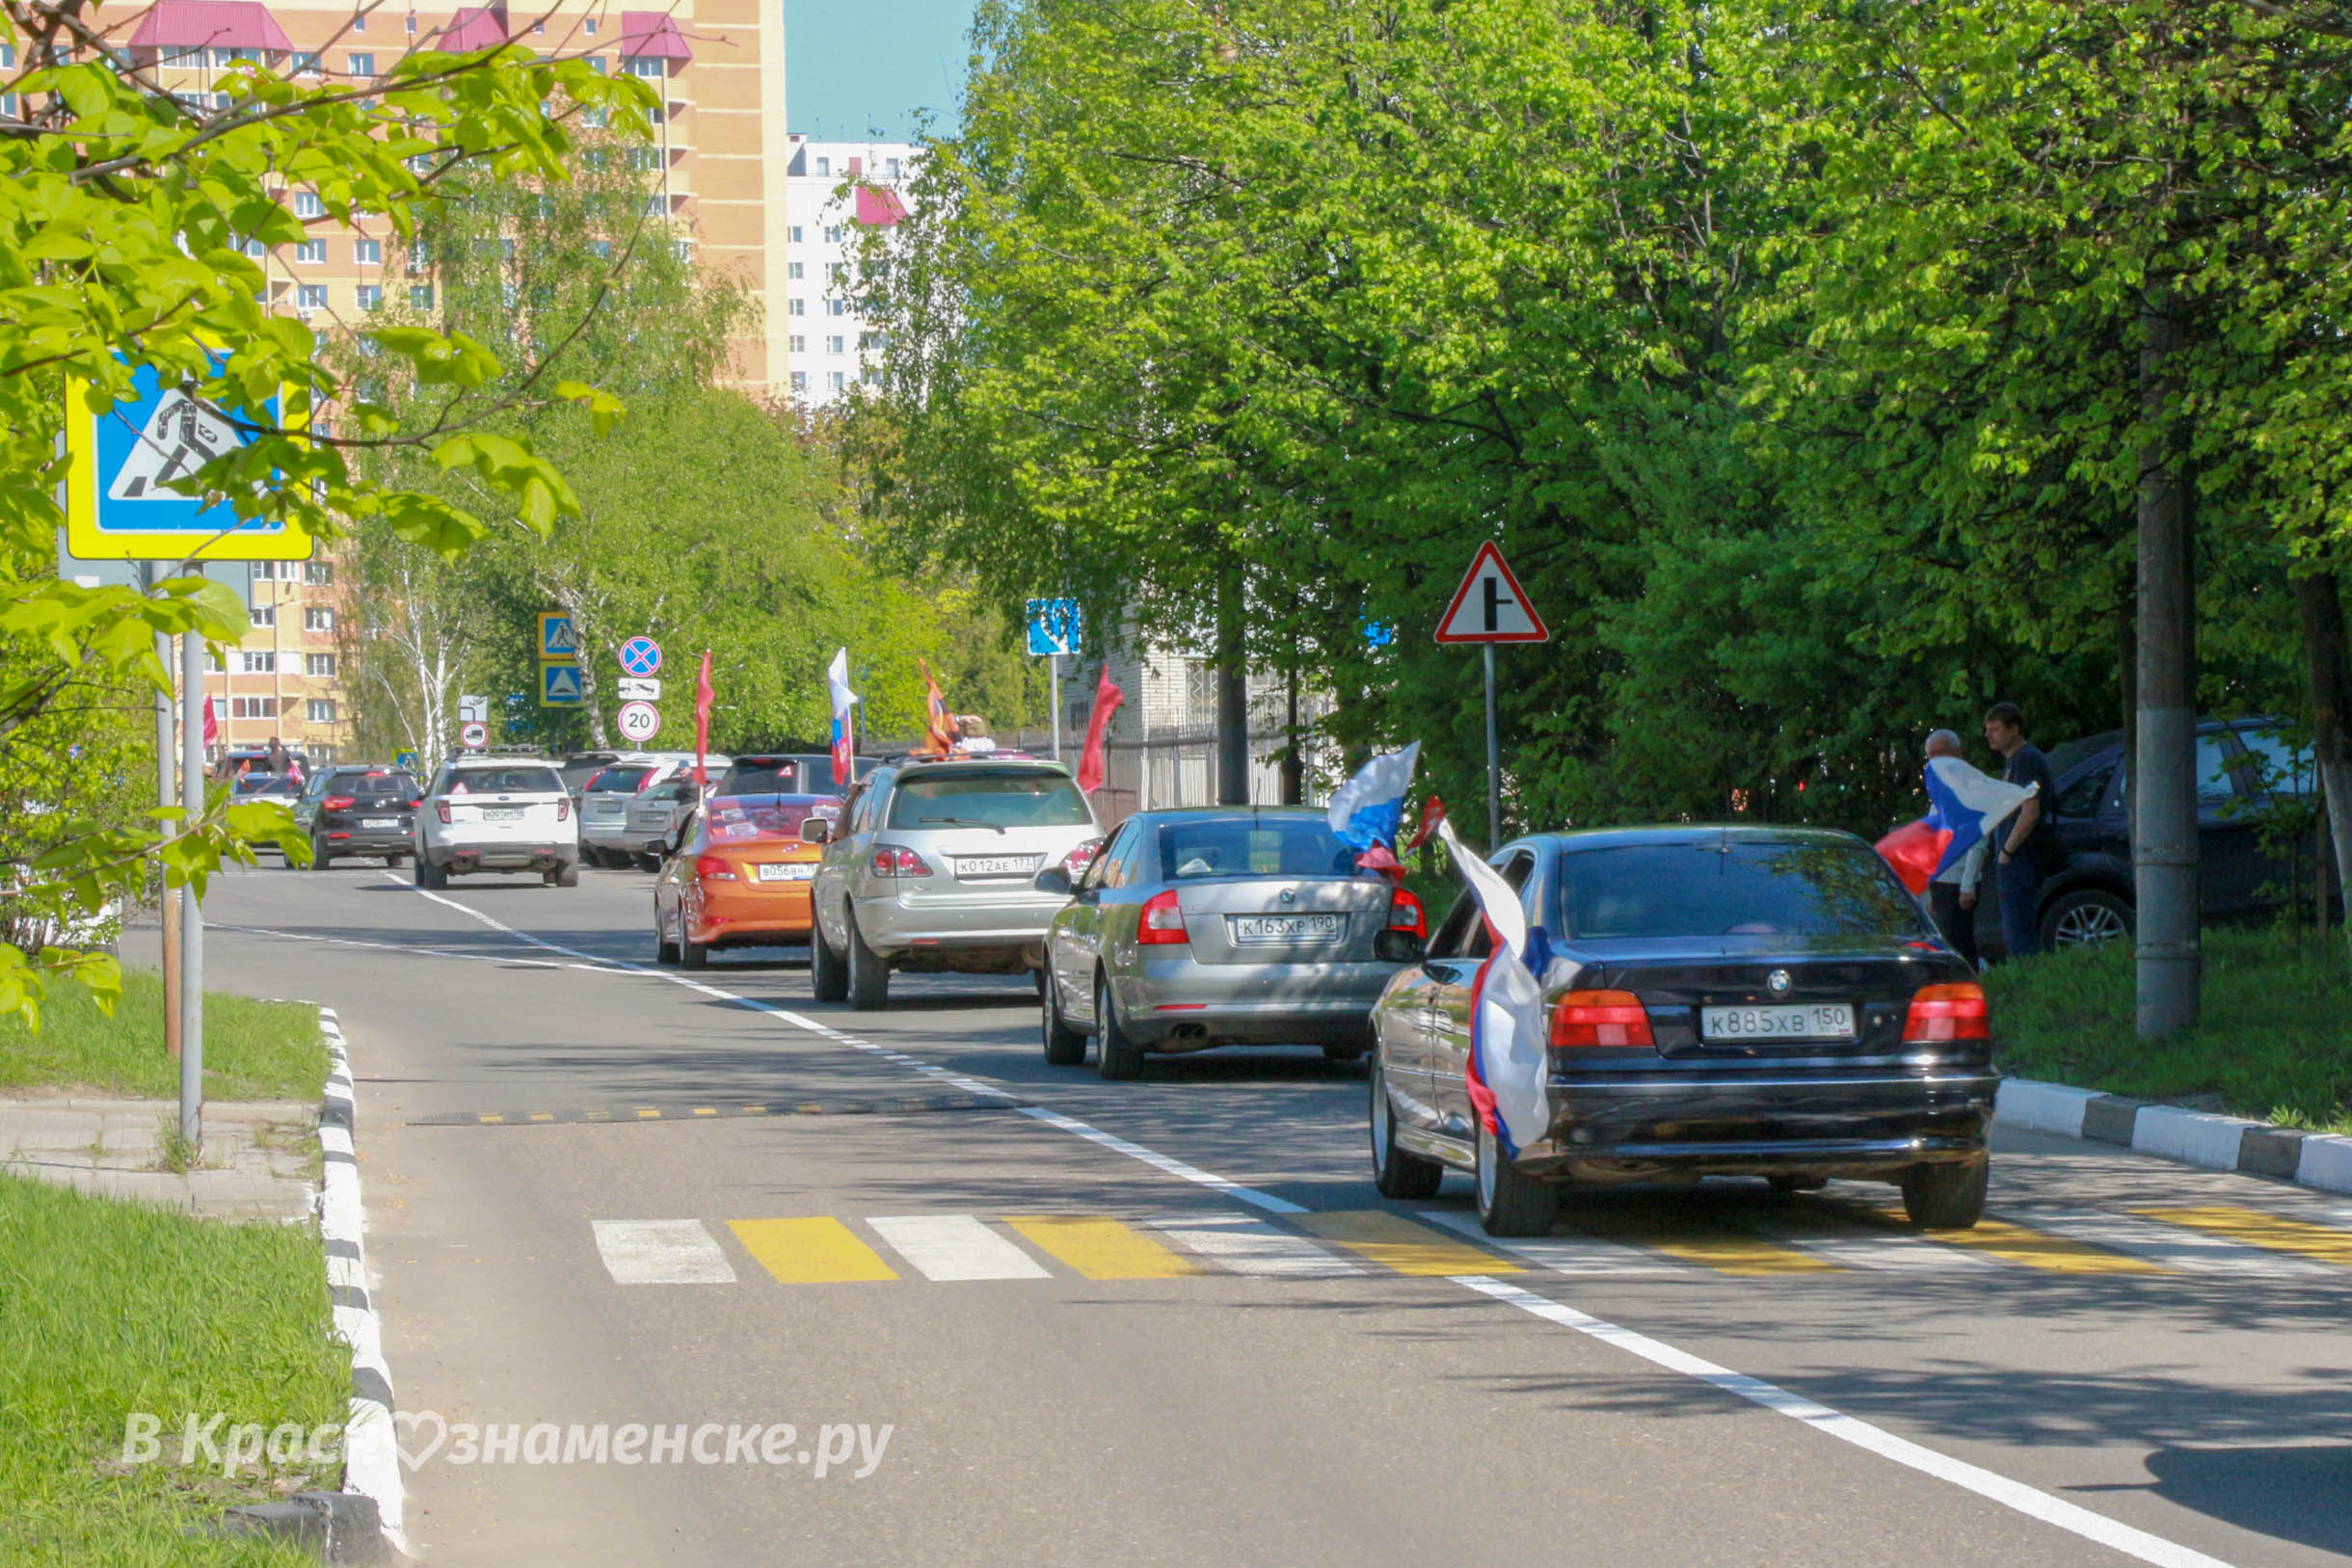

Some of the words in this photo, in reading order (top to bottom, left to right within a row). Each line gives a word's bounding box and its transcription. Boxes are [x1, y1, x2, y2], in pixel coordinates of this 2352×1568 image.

[628, 712, 651, 729] 20
[960, 860, 1009, 872] К012АЕ
[1243, 917, 1305, 935] К163ХР
[1310, 916, 1333, 931] 190
[1711, 1011, 1805, 1034] К885ХВ
[1812, 1008, 1845, 1025] 150
